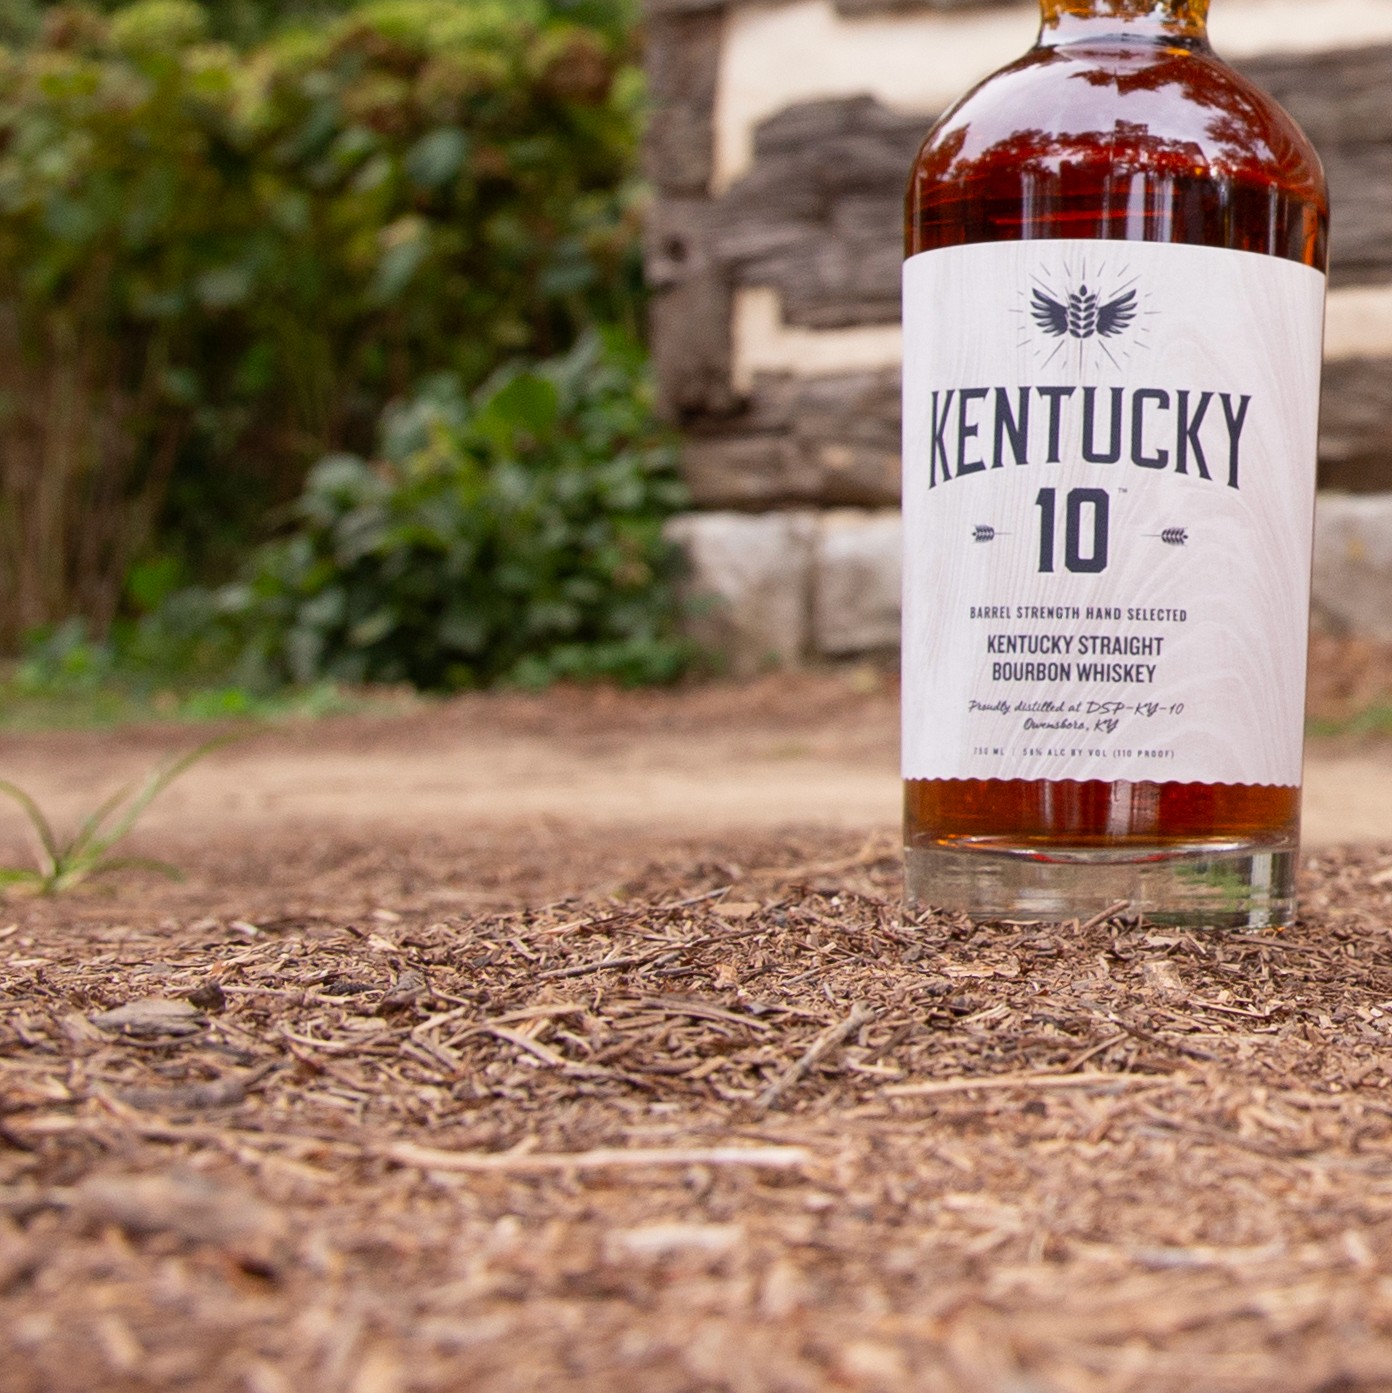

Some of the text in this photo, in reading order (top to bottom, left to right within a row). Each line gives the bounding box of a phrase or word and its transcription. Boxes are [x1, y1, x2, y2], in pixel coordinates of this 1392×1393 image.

[928, 386, 1252, 490] KENTUCKY
[1035, 487, 1110, 573] 10
[970, 606, 1187, 622] BARREL STRENGTH HAND SELECTED
[987, 634, 1164, 656] KENTUCKY STRAIGHT
[992, 662, 1157, 684] BOURBON WHISKEY
[968, 699, 1185, 717] Proudly distilled at DSP-KY-10
[1023, 717, 1119, 734] Owensboro, KY
[1137, 748, 1175, 759] PROOF)
